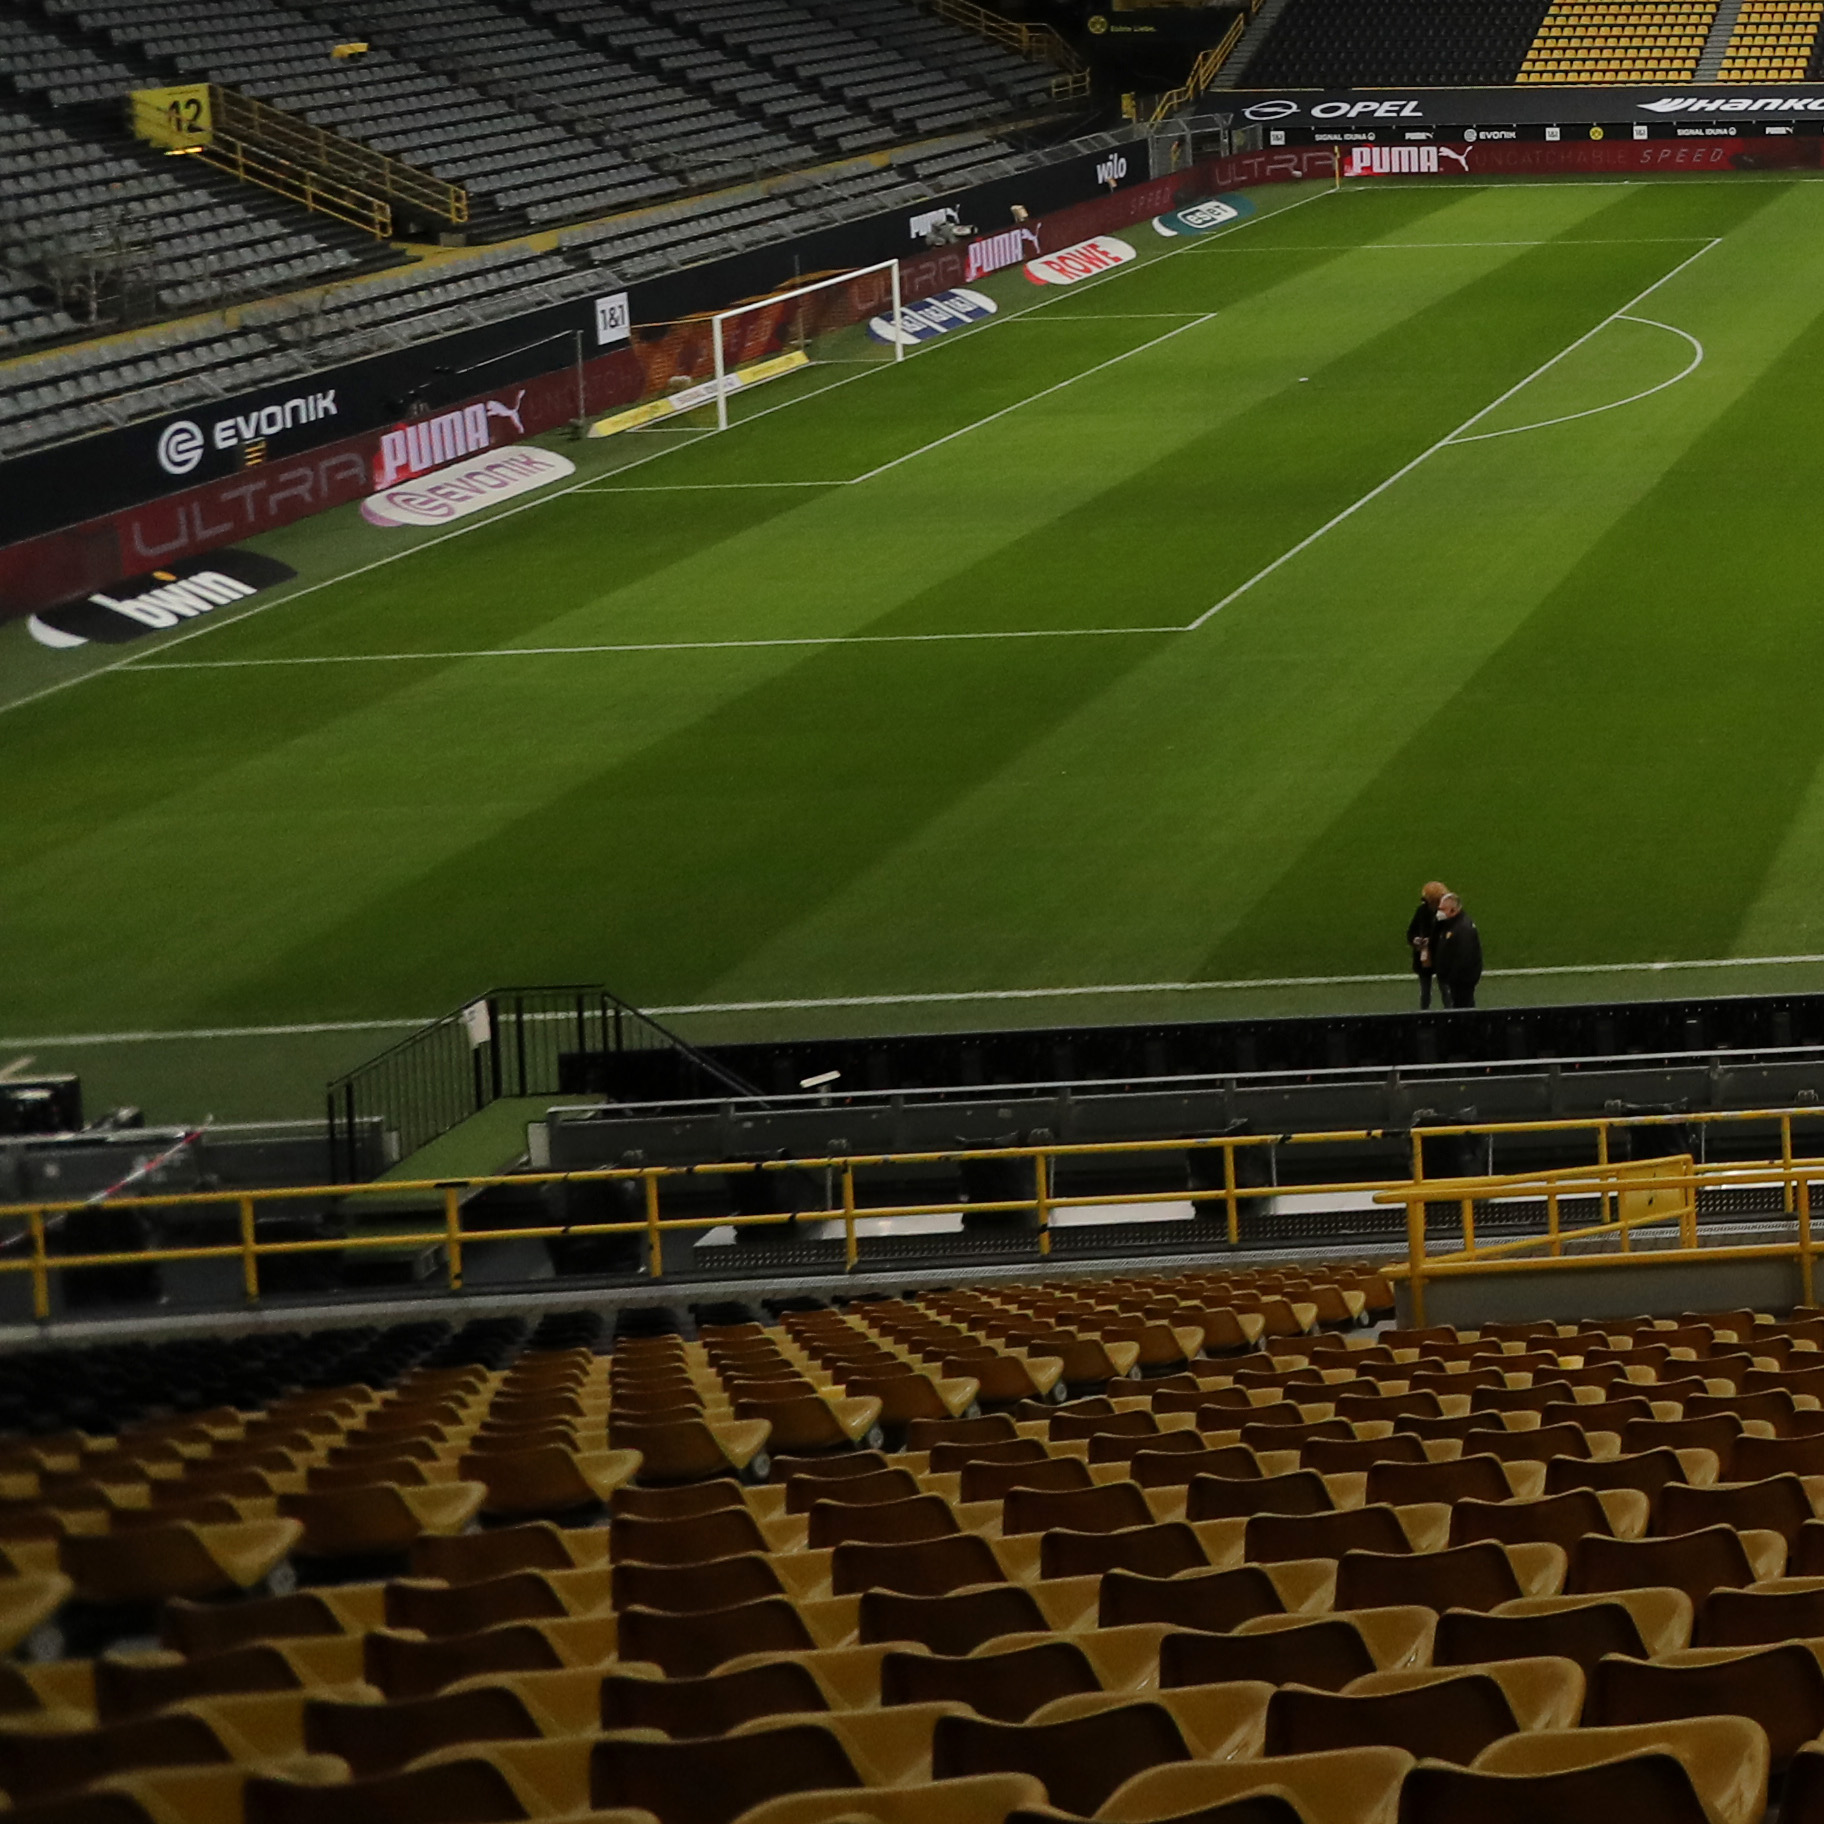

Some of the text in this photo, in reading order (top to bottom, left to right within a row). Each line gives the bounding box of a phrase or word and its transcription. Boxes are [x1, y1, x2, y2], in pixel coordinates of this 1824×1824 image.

[169, 98, 204, 133] 12
[1311, 100, 1423, 118] OPEL
[1479, 130, 1516, 140] EVONIK
[1096, 152, 1127, 185] wilo
[1216, 151, 1338, 186] ULTRA
[1351, 146, 1438, 173] PUMA
[1640, 147, 1723, 163] SPEED
[967, 227, 1023, 280] PUMA
[1043, 243, 1123, 280] ROWE
[600, 304, 626, 331] 1&1
[213, 389, 339, 450] EVONIK
[379, 402, 490, 489] PUMA
[427, 453, 554, 504] EVONIK
[133, 452, 367, 556] ULTRA
[91, 570, 258, 628] bwin
